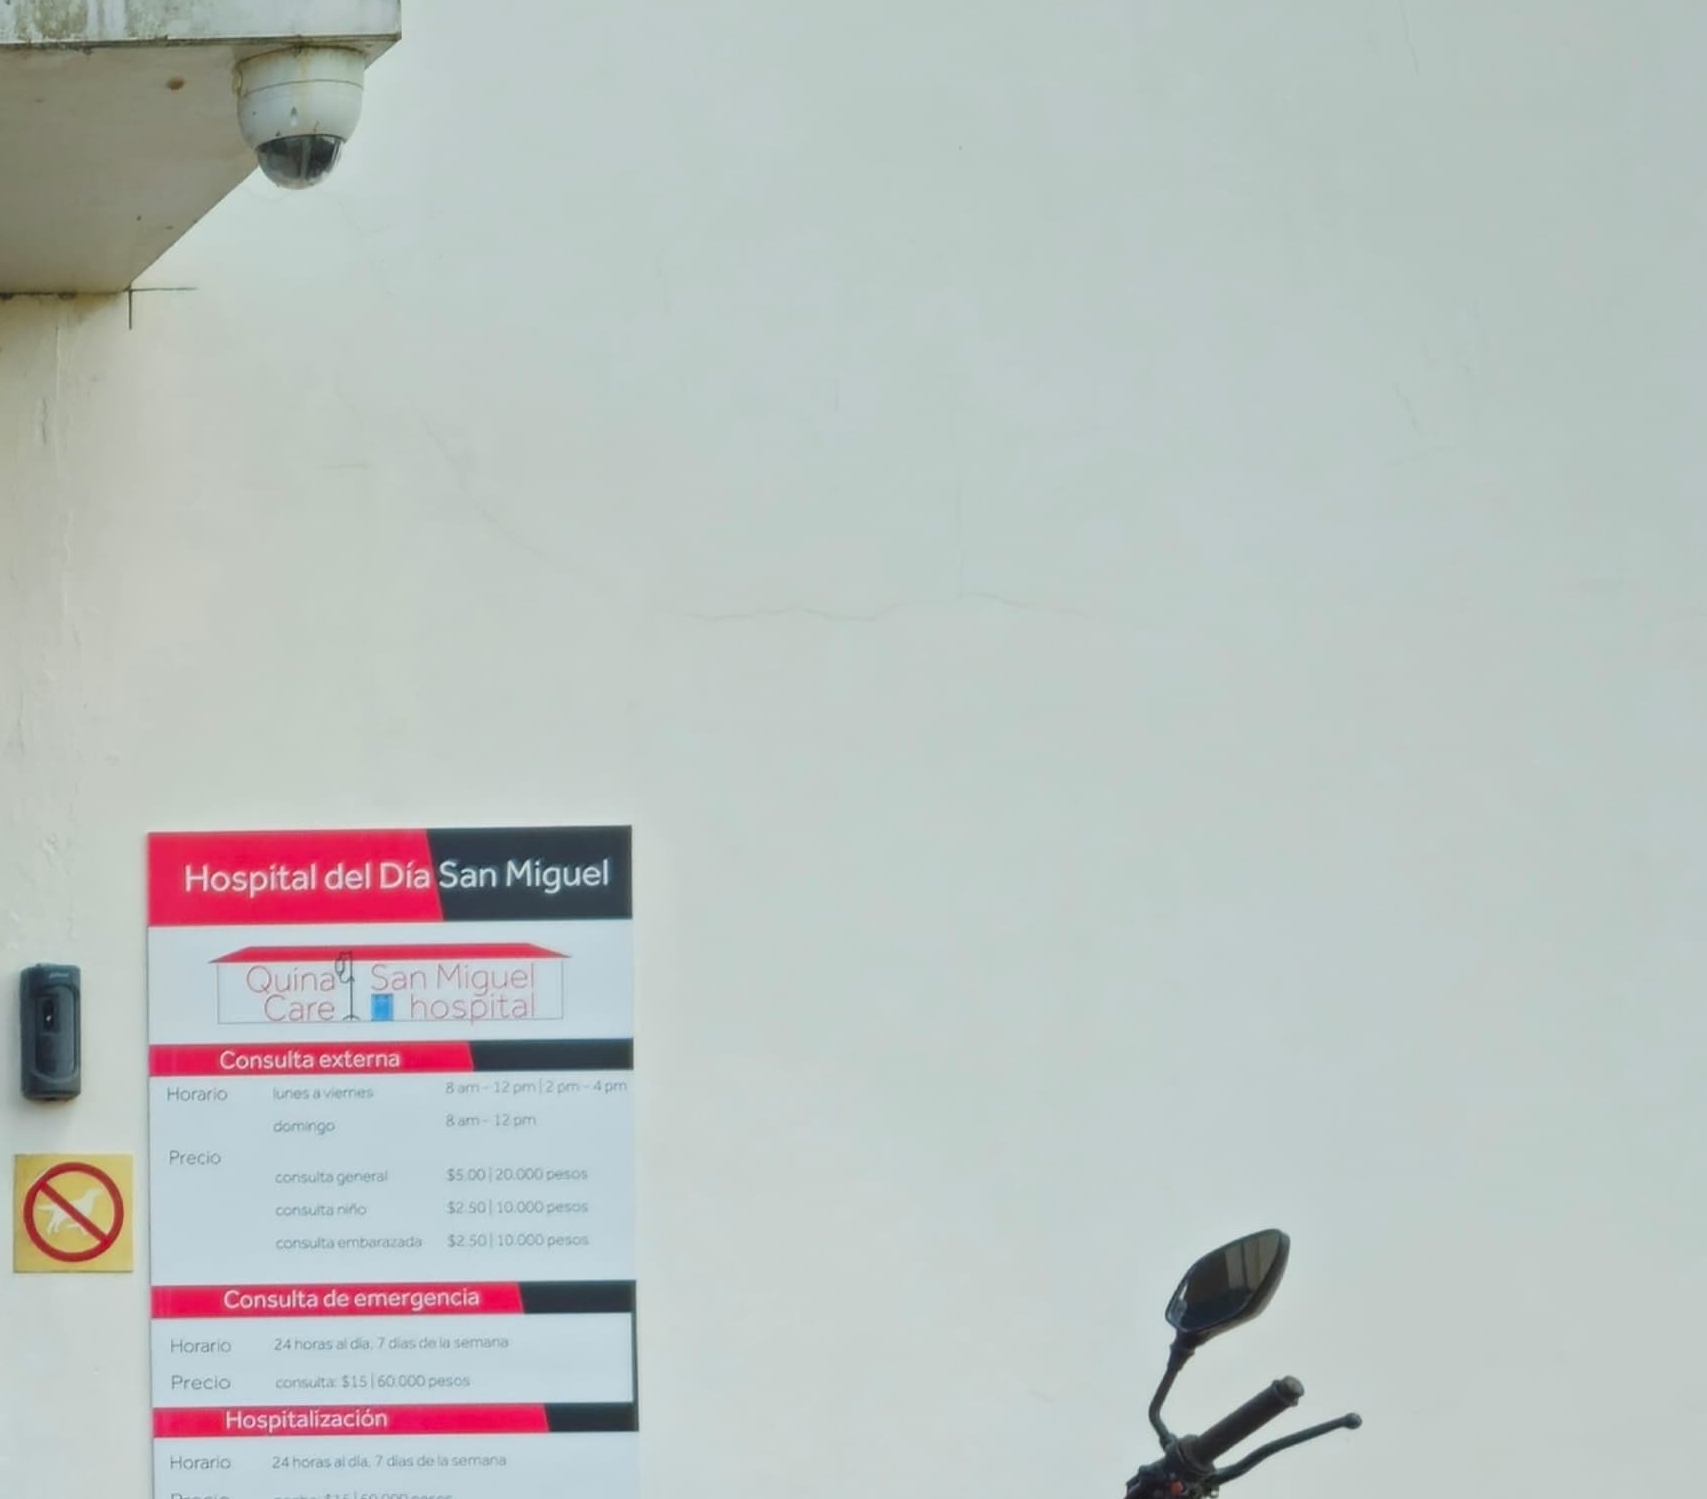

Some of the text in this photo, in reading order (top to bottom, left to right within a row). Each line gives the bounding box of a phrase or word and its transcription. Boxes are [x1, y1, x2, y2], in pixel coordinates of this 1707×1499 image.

[184, 857, 610, 899] Hospital del Día San Miguel
[245, 962, 536, 998] Quina San Miguel
[263, 992, 536, 1025] Care hospital
[218, 1049, 401, 1071] Consulta externa
[166, 1086, 229, 1102] Horario
[272, 1086, 310, 1100] lunes
[312, 1089, 321, 1100] a
[322, 1085, 374, 1100] viernes
[445, 1081, 455, 1094] 8
[457, 1083, 480, 1094] am
[493, 1080, 510, 1094] 12
[512, 1082, 536, 1096] pm
[272, 1119, 336, 1135] domingo
[445, 1114, 455, 1127] 8
[457, 1116, 480, 1127] am
[494, 1113, 510, 1127] 12
[512, 1115, 537, 1129] pm
[168, 1149, 222, 1166] Precio
[274, 1170, 334, 1185] consulta
[336, 1169, 389, 1186] general
[546, 1169, 589, 1183] pesos
[275, 1203, 335, 1217] consulta
[336, 1202, 368, 1217] niño
[546, 1202, 590, 1216] pesos
[275, 1236, 335, 1250] consulta
[336, 1234, 423, 1250] embarazada
[546, 1235, 590, 1249] pesos
[223, 1287, 480, 1312] Consulta de emergencia
[170, 1339, 232, 1354] Horario
[273, 1337, 291, 1351] 24
[293, 1337, 333, 1351] horas
[335, 1336, 348, 1351] al
[377, 1336, 386, 1349] 7
[418, 1335, 437, 1350] de
[453, 1336, 510, 1350] semana
[170, 1374, 232, 1391] Precio
[427, 1375, 471, 1390] pesos
[225, 1408, 388, 1434] Hospitalización
[169, 1455, 232, 1471] Horario
[271, 1455, 290, 1469] 24
[292, 1455, 332, 1470] horas
[333, 1454, 346, 1469] al
[375, 1454, 384, 1468] 7
[416, 1453, 435, 1468] de
[451, 1454, 507, 1468] semana
